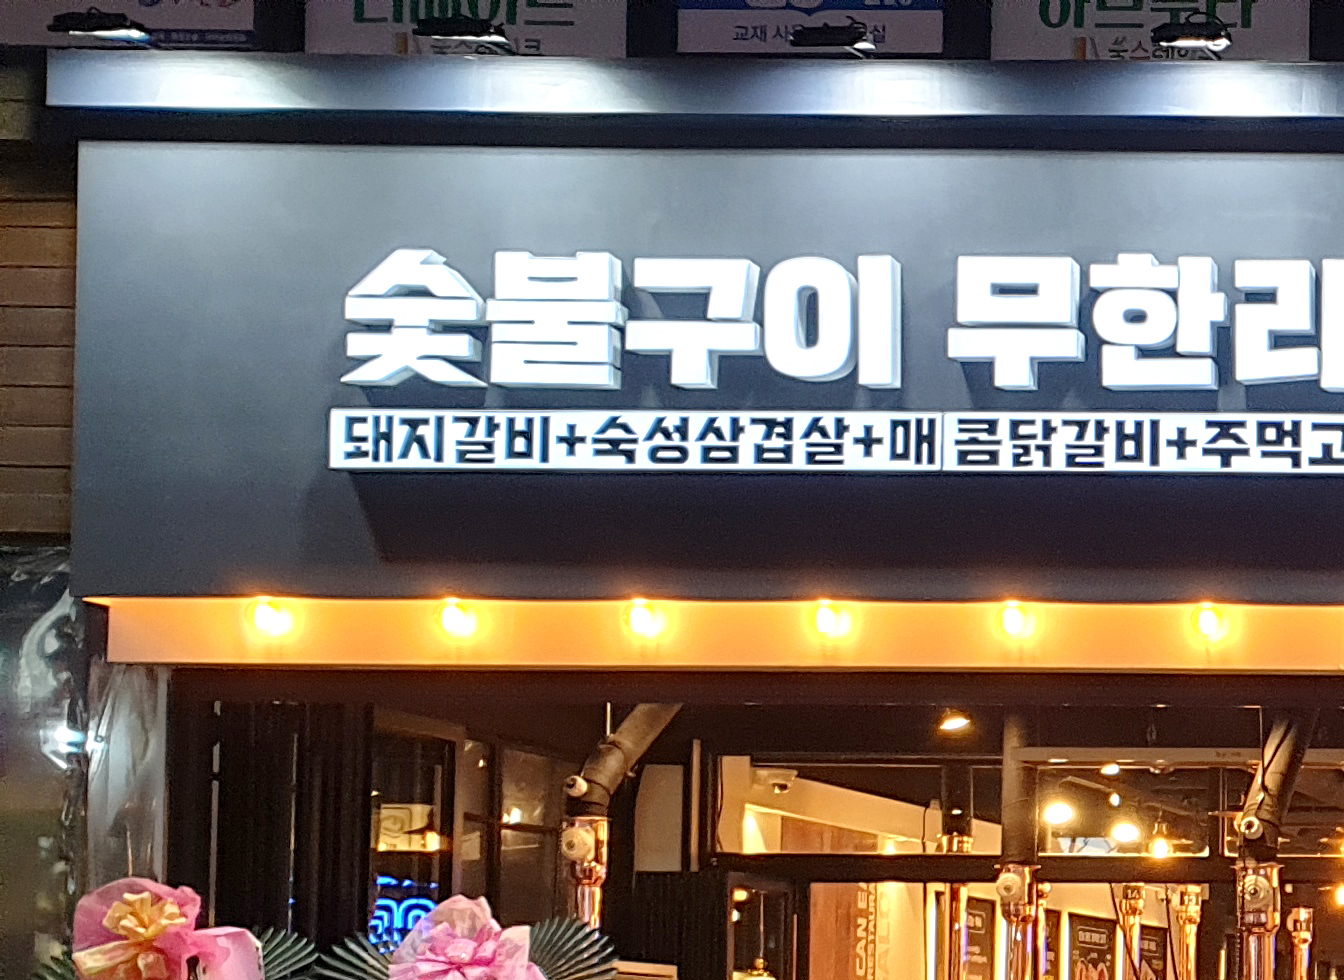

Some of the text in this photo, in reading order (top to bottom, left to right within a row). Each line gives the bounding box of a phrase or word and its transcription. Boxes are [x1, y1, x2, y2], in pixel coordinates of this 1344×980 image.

[733, 25, 768, 42] 교재
[339, 248, 904, 391] 숯불구이
[855, 918, 867, 977] CAN
